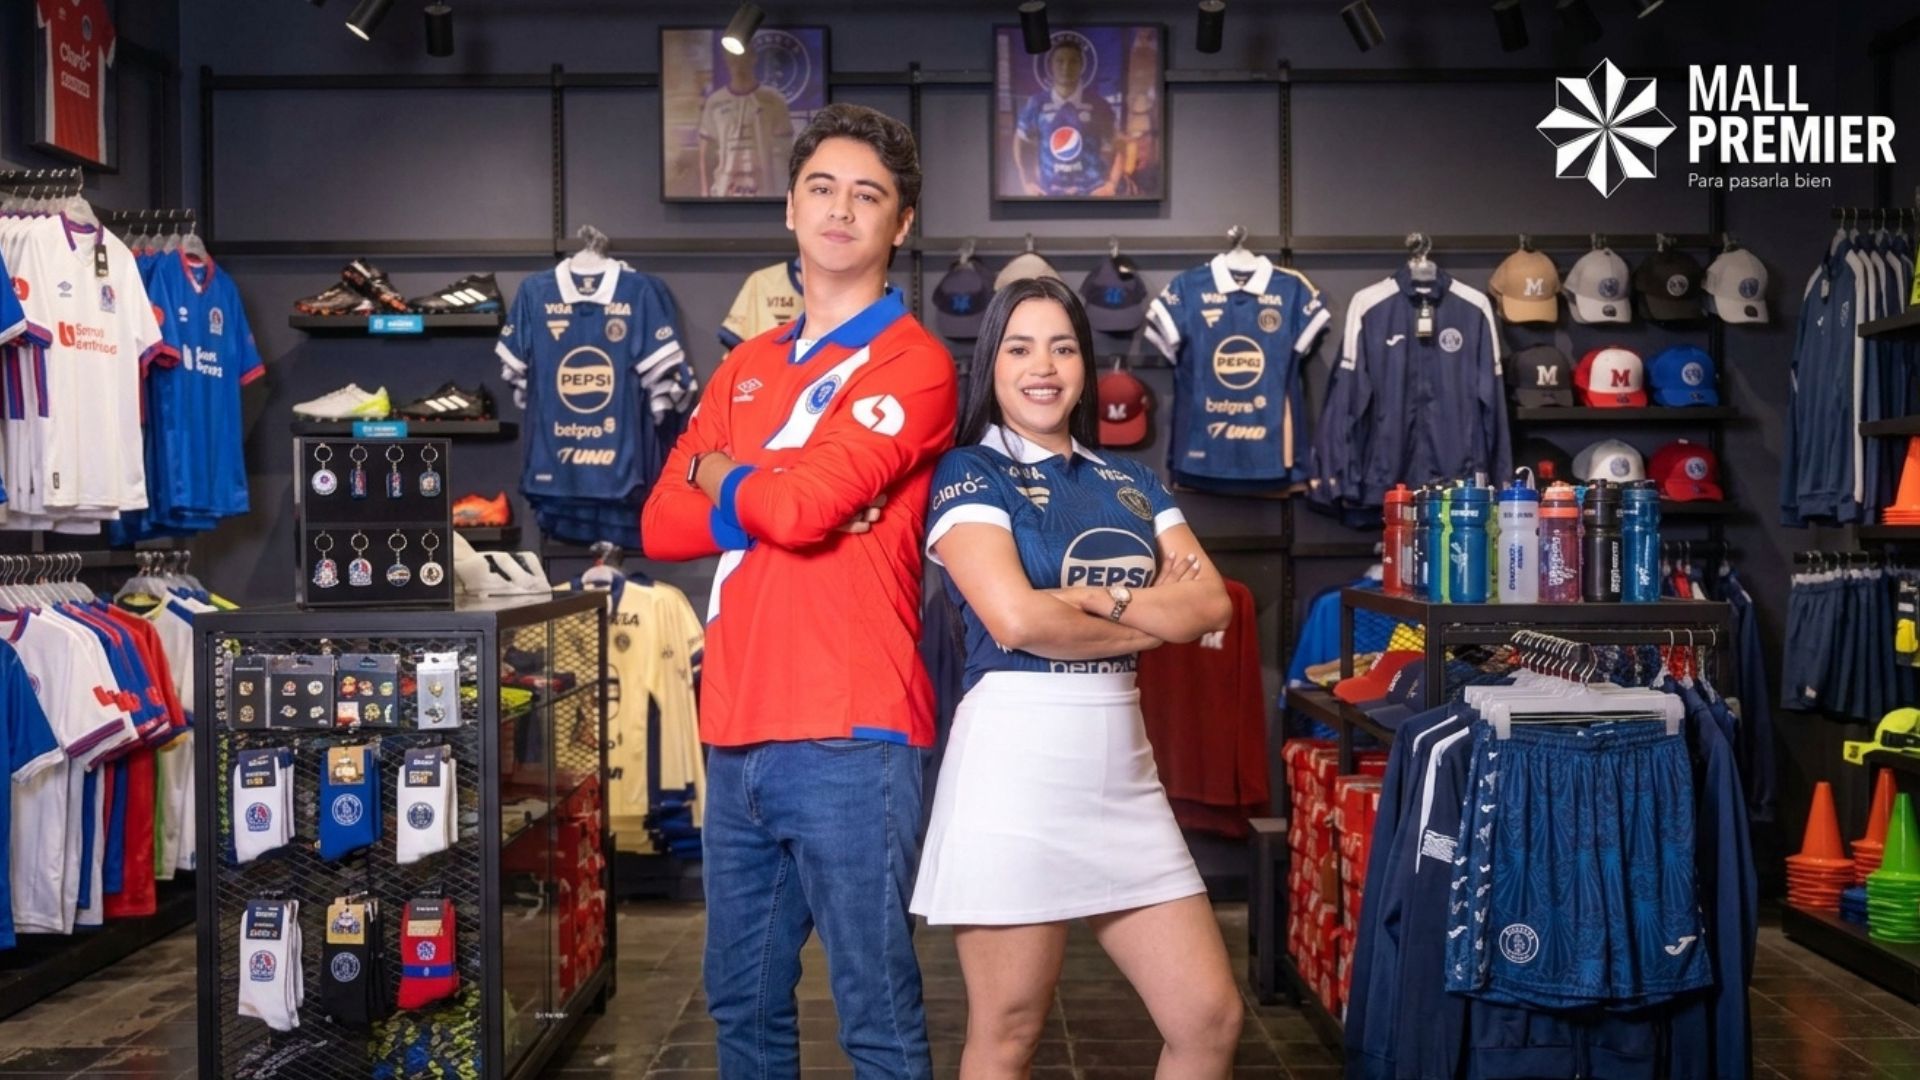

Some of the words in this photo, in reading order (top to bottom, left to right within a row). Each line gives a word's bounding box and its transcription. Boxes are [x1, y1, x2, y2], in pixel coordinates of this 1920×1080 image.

[1524, 278, 1544, 296] M
[560, 373, 611, 387] PEPSI
[1536, 365, 1558, 385] M
[1611, 369, 1631, 387] M
[554, 422, 602, 440] betpro
[573, 449, 616, 465] UNO
[1067, 566, 1152, 588] PEPSI
